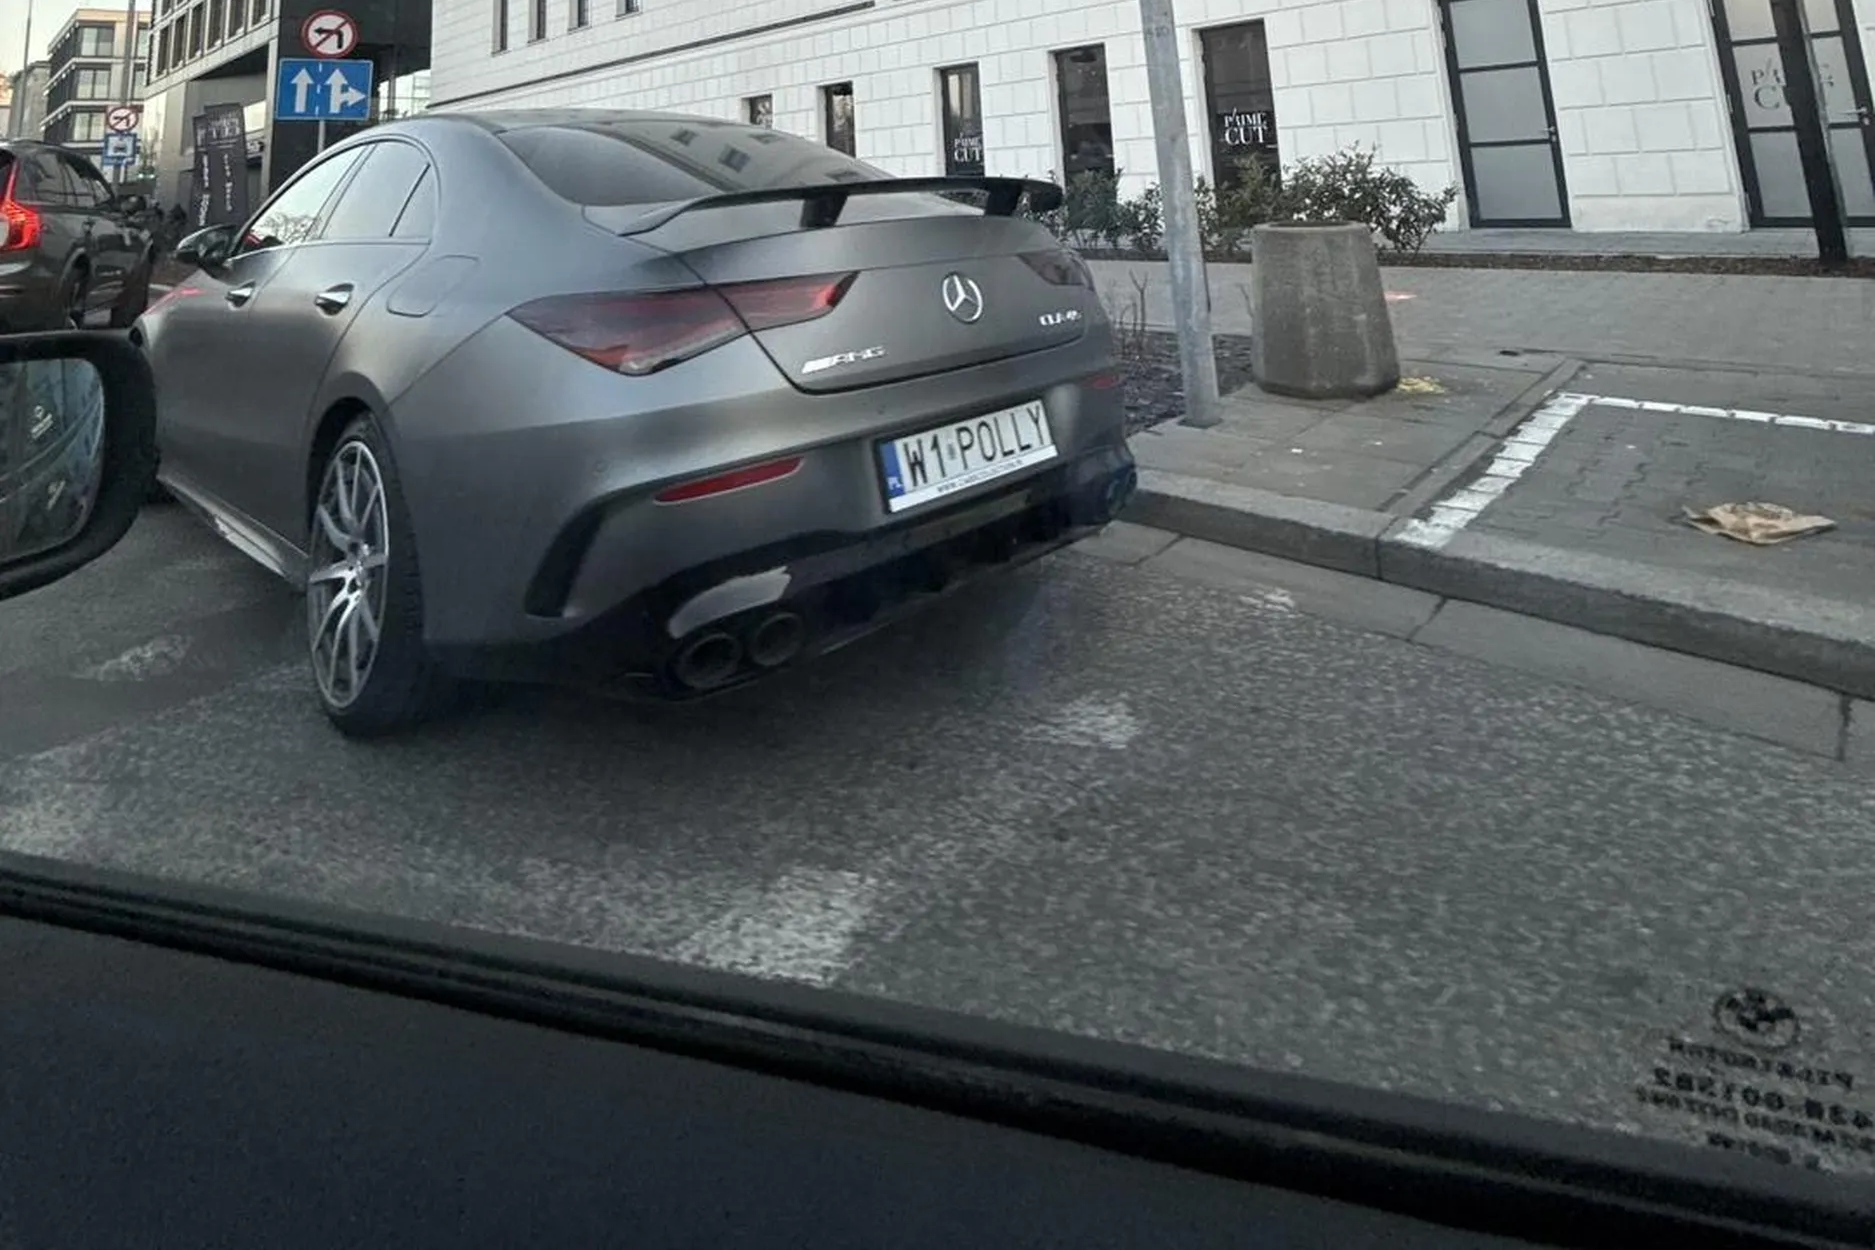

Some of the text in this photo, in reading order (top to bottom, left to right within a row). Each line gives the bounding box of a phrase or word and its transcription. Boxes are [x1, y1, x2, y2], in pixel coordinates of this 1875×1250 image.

[1224, 125, 1264, 145] CUT
[954, 147, 980, 162] CUT
[903, 434, 946, 487] W1
[955, 404, 1044, 470] POLLY
